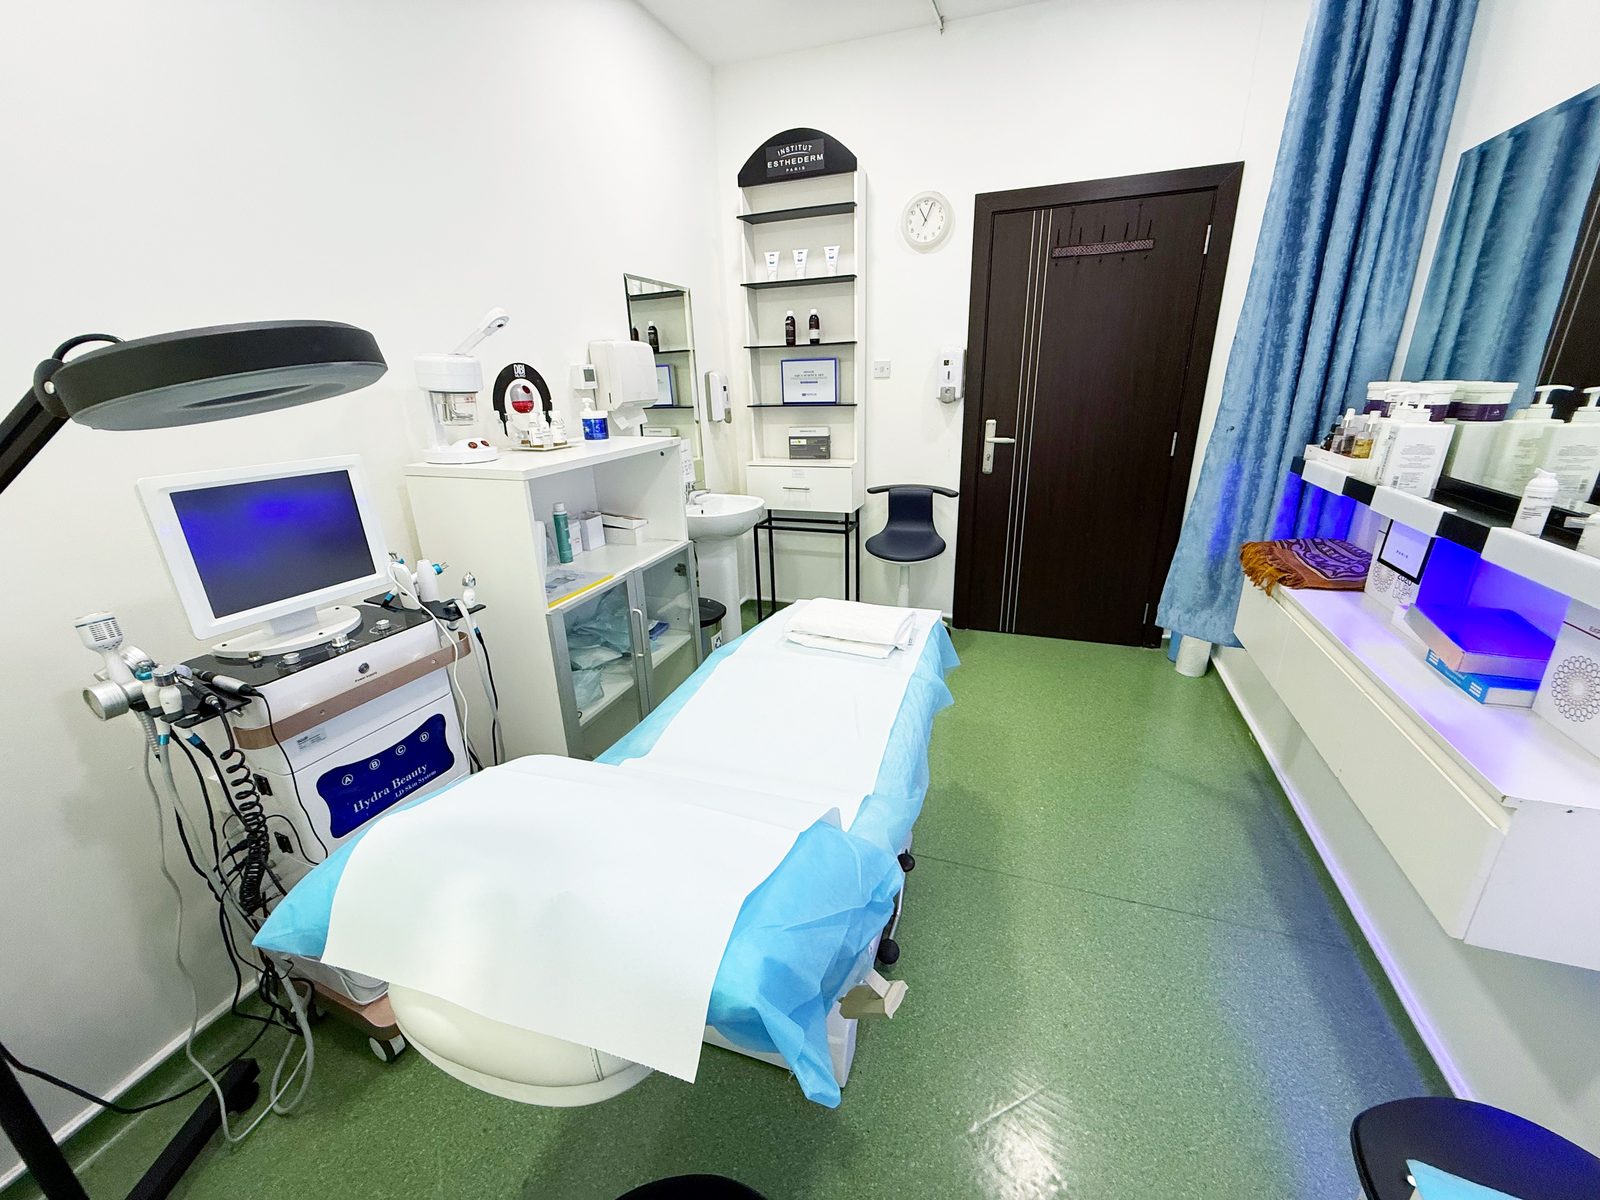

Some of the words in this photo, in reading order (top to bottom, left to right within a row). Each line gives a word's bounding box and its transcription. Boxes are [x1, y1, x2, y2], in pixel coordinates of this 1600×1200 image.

[777, 144, 812, 157] INSTITUT
[767, 153, 824, 169] ESTHEDERM
[353, 787, 391, 813] Hydra
[392, 764, 428, 788] Beauty
